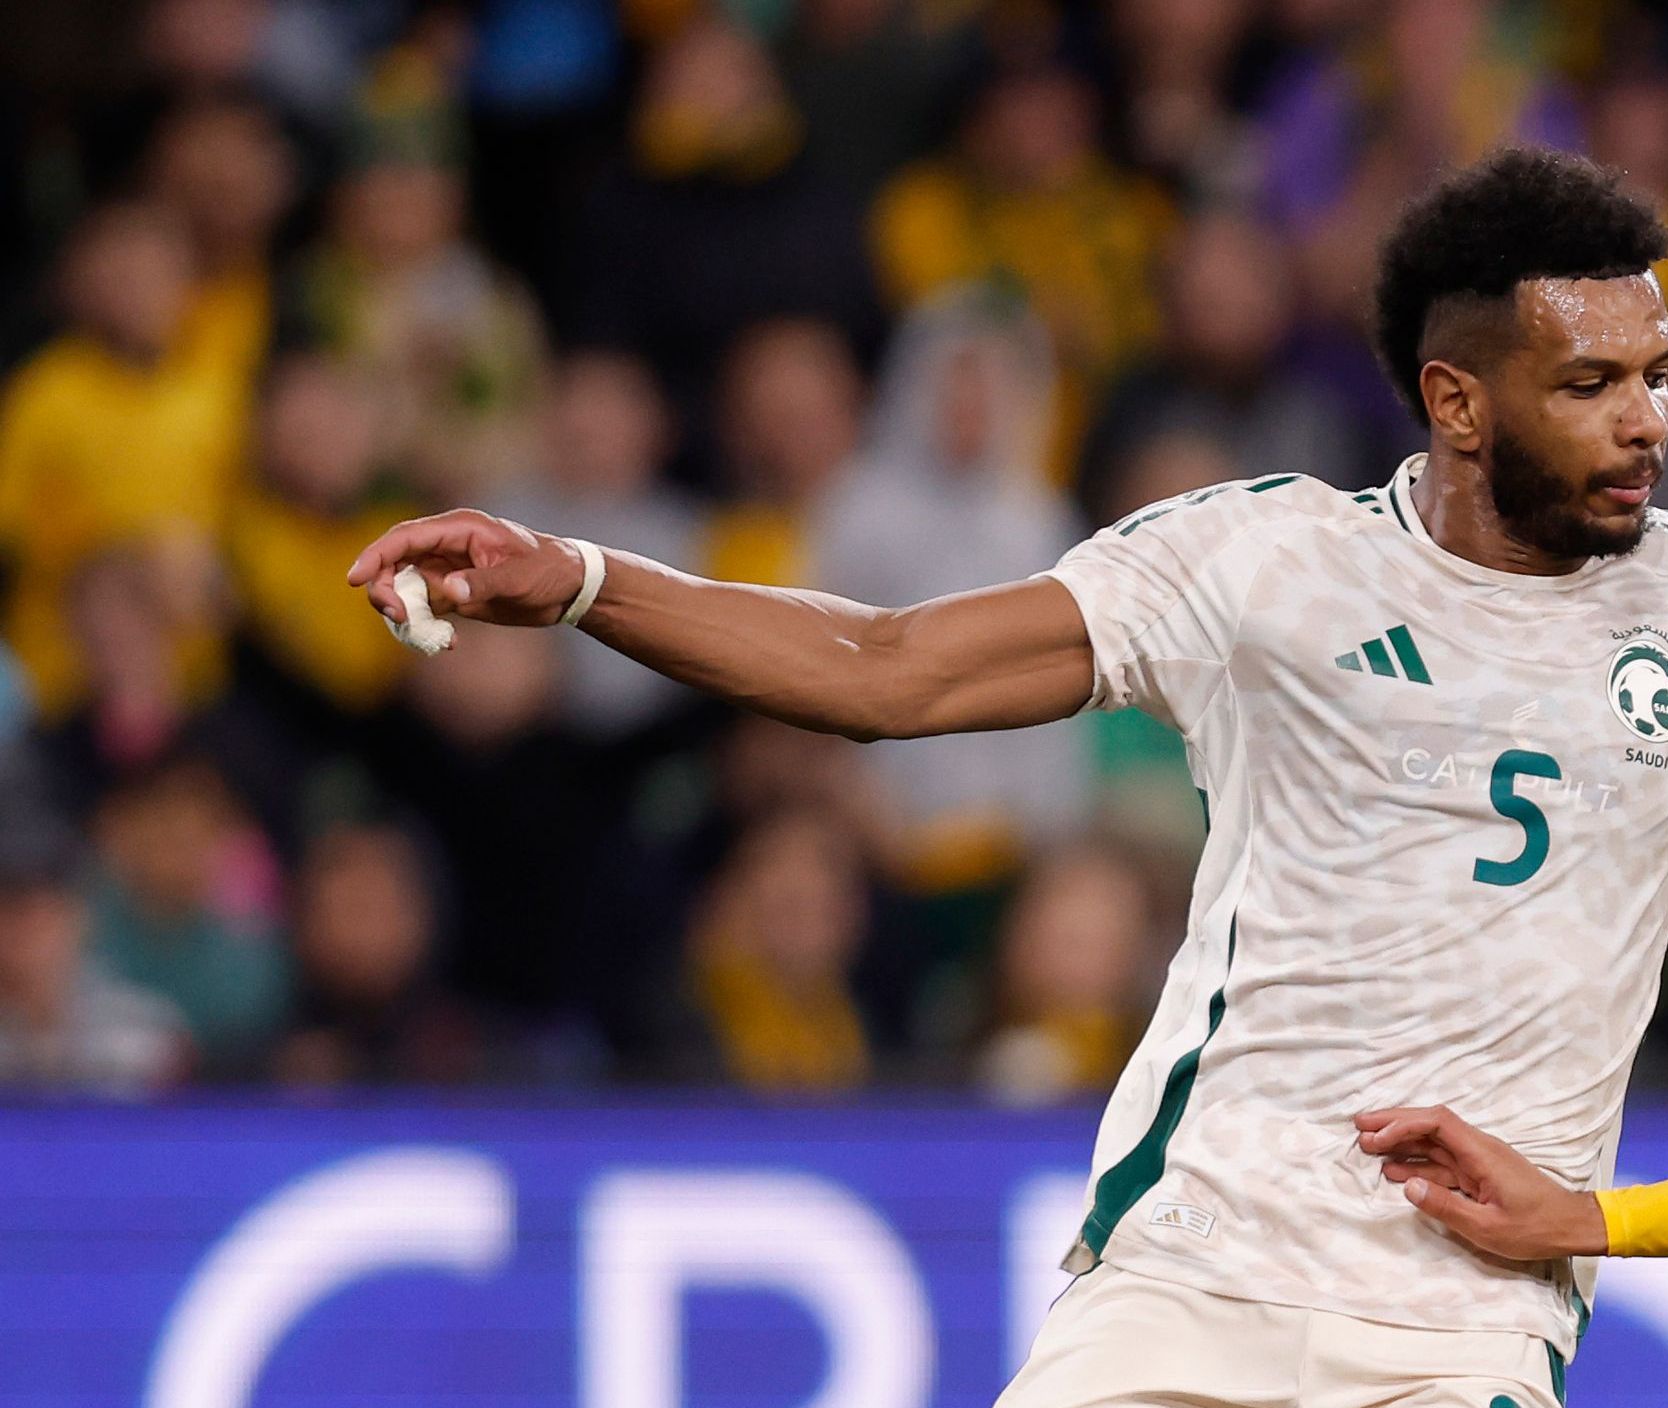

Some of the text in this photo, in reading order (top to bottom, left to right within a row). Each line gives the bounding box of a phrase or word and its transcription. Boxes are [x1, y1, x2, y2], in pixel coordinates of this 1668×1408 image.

[1402, 747, 1618, 814] CATULT
[1625, 748, 1668, 770] SAUDI
[1472, 748, 1562, 887] 5
